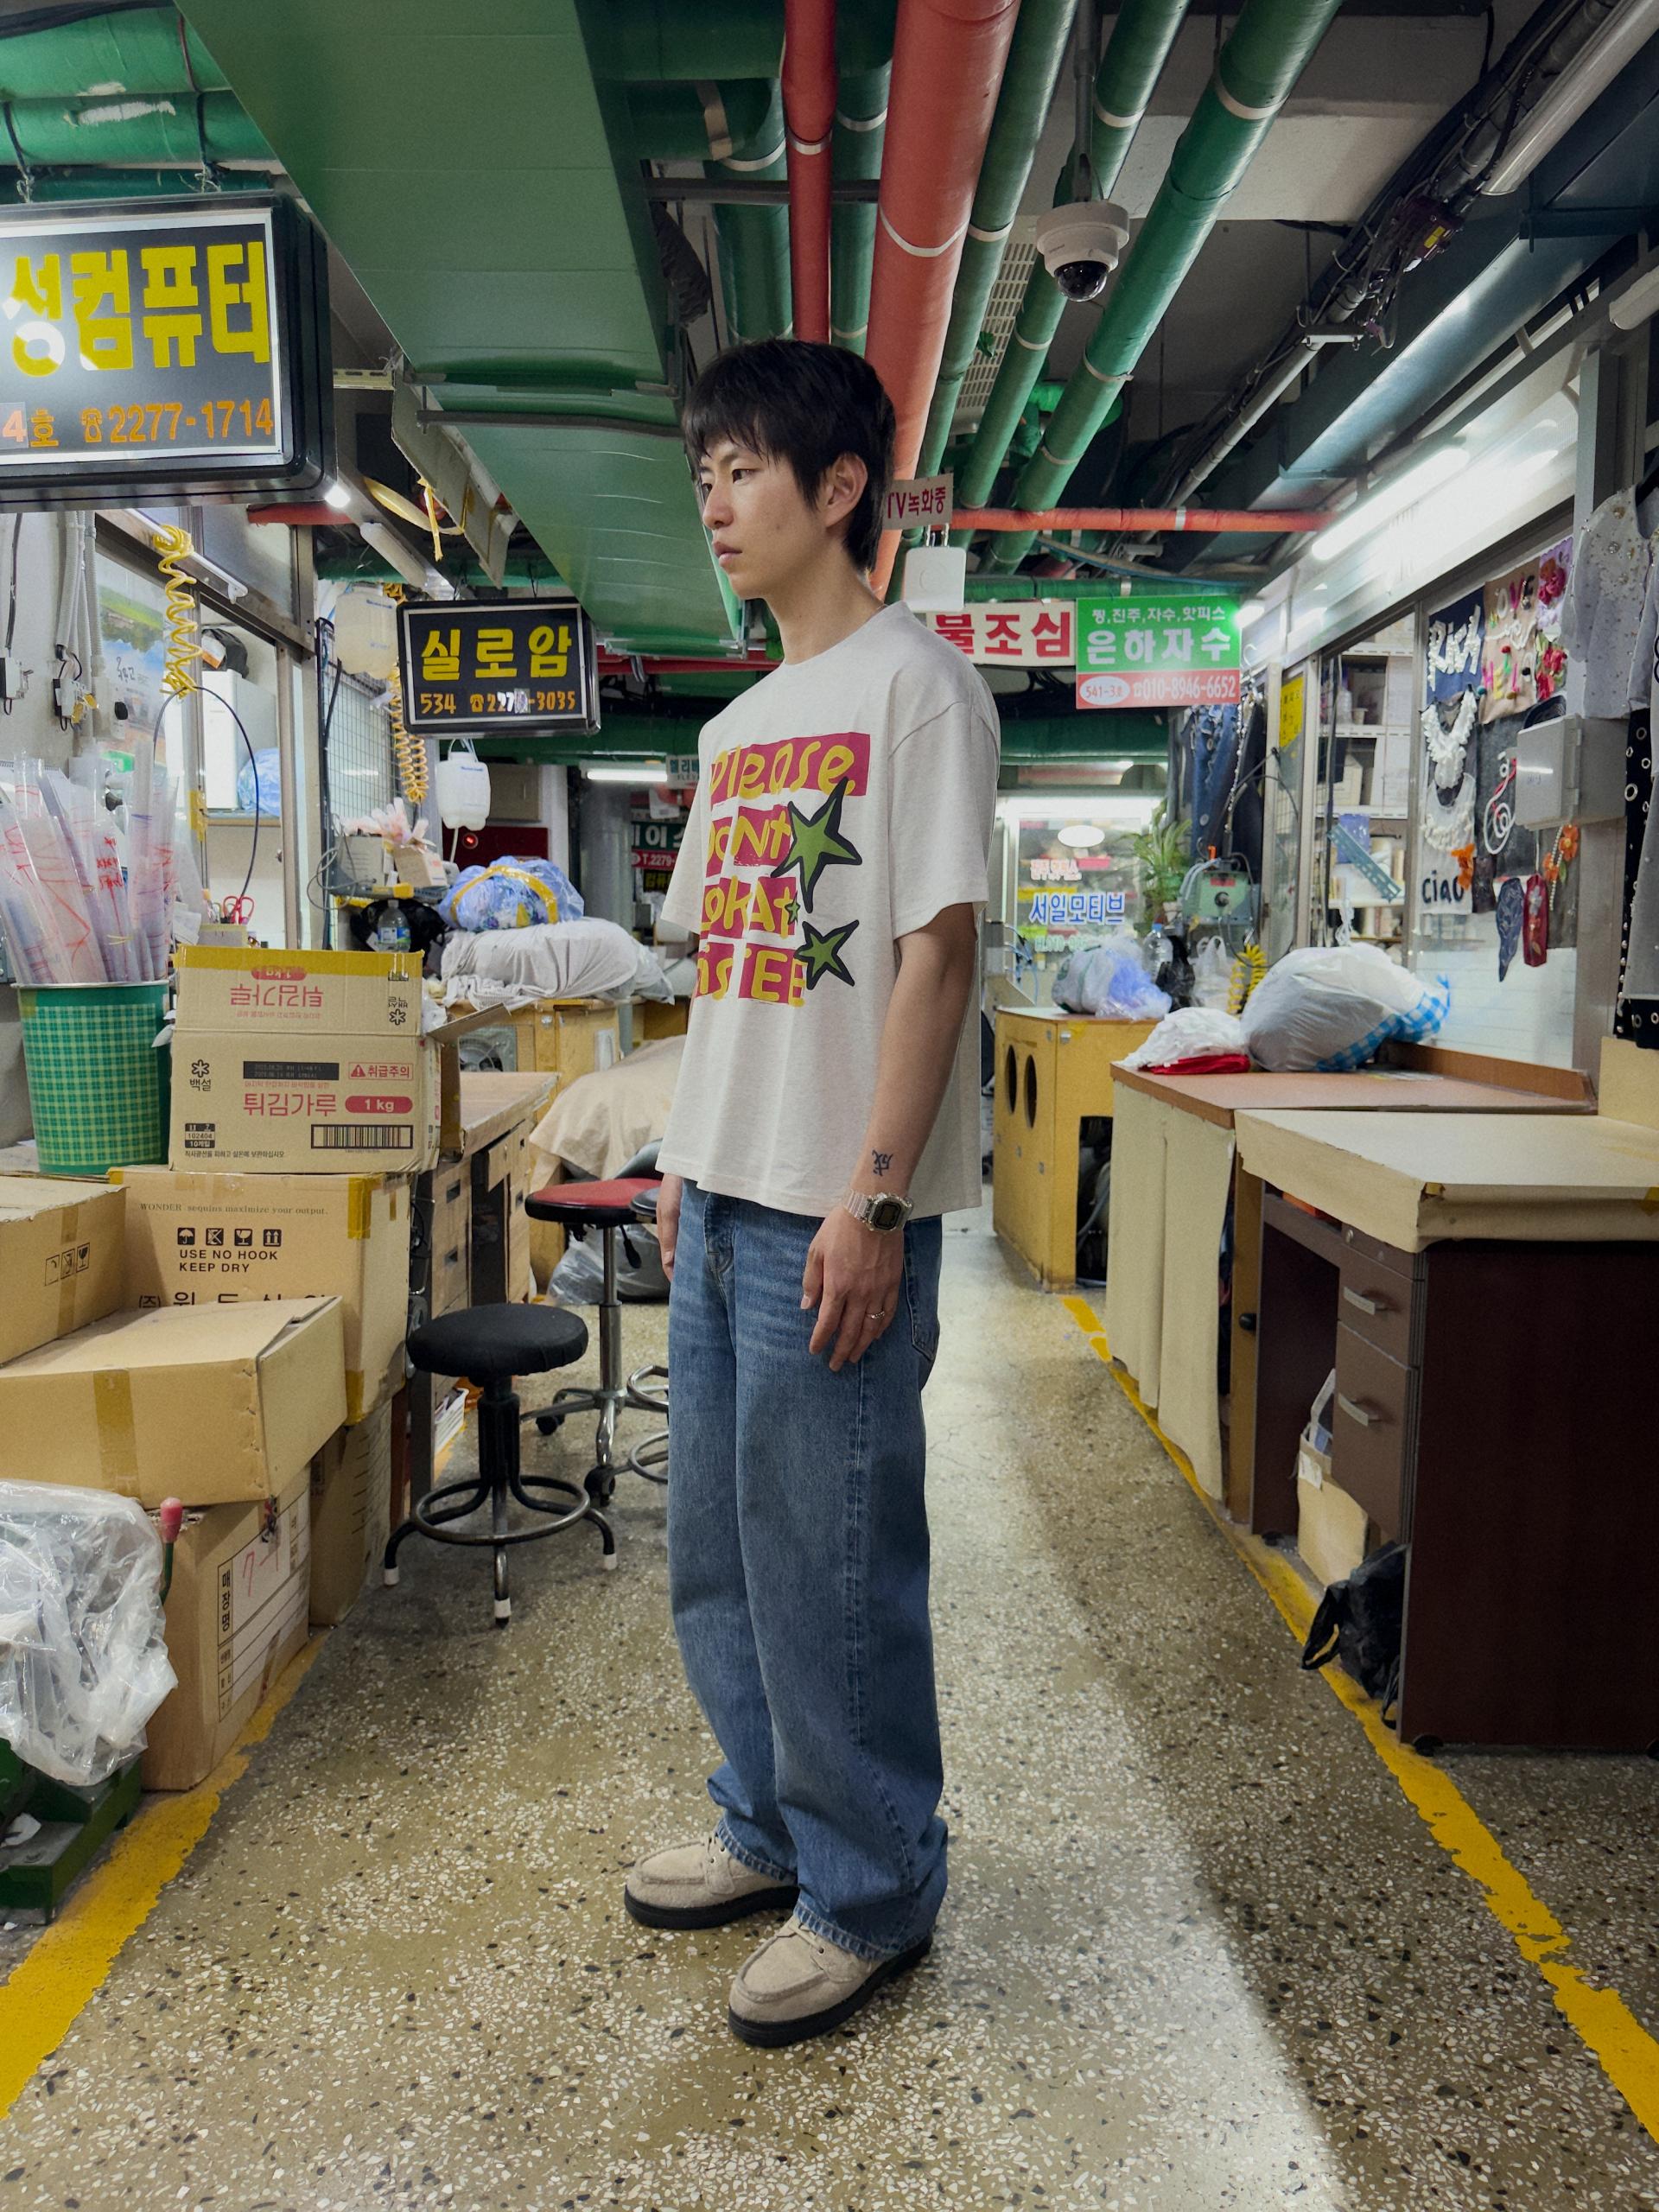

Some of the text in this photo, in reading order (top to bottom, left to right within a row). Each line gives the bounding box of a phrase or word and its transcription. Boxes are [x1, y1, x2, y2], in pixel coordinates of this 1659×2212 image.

[3, 241, 270, 377] 성컴퓨터
[109, 397, 273, 443] 2277-1714
[935, 611, 1071, 657] 불조심
[1086, 627, 1231, 665] 은하자수
[421, 625, 573, 682] 실로암
[1142, 675, 1236, 700] 010-8946-6652
[420, 690, 576, 715] 534 227-3035
[230, 983, 325, 1007] 튀김가루
[367, 1065, 410, 1078] 취급주의
[189, 1078, 212, 1092] 백설
[243, 1093, 395, 1117] 튀김가루 1 kg
[139, 1203, 182, 1211] WONDER
[180, 1249, 278, 1261] USE NO HOOK
[179, 1262, 251, 1273] KEEP DRY
